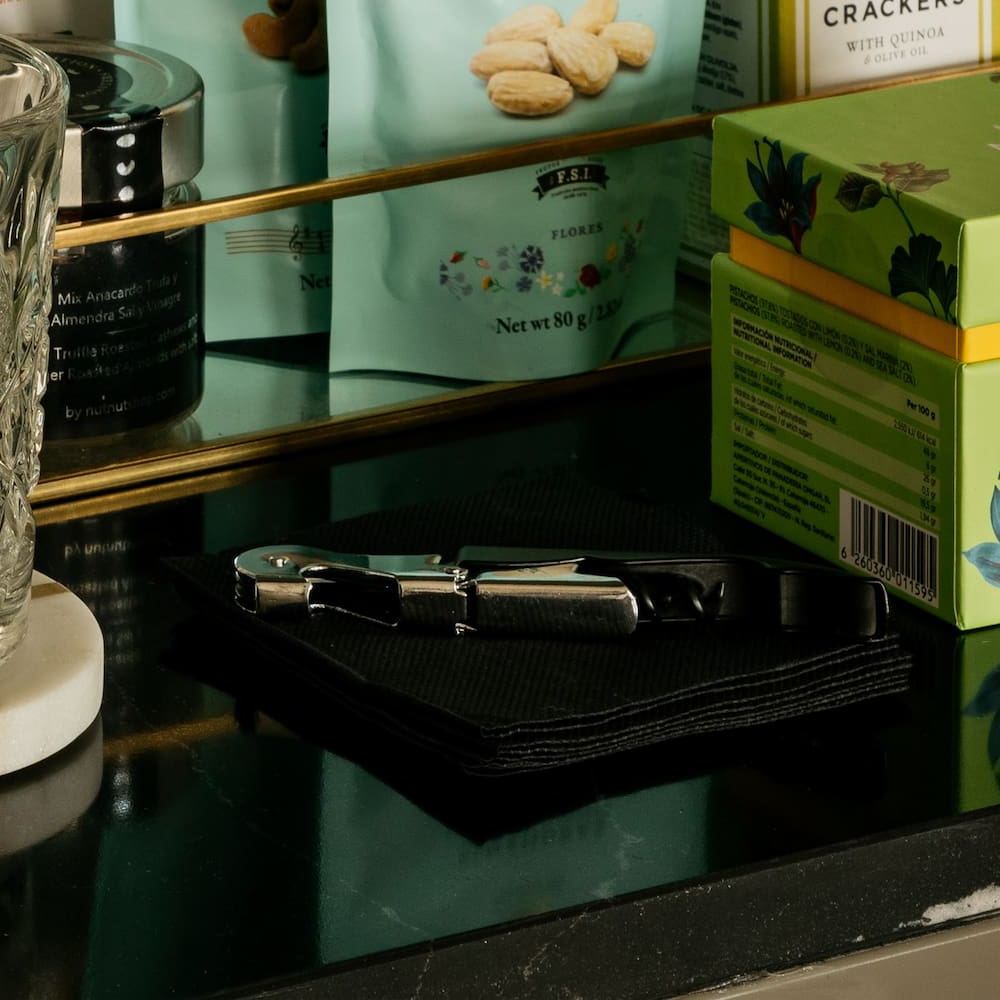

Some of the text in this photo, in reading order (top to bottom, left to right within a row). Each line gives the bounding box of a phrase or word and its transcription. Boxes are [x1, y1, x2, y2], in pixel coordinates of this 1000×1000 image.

[847, 26, 945, 53] WITH QUINOA
[874, 50, 906, 64] OLIVE
[910, 46, 928, 56] OIL
[551, 222, 604, 240] FLORES
[300, 274, 330, 290] Net
[57, 291, 82, 306] Mix
[86, 283, 143, 304] Anacardo
[51, 310, 115, 327] Almendra
[496, 317, 527, 335] Net
[530, 315, 551, 332] wt
[554, 311, 573, 329] 80
[66, 404, 82, 421] by
[907, 398, 916, 411] Per
[918, 404, 928, 417] 100
[841, 547, 933, 603] 6 260360 011595
